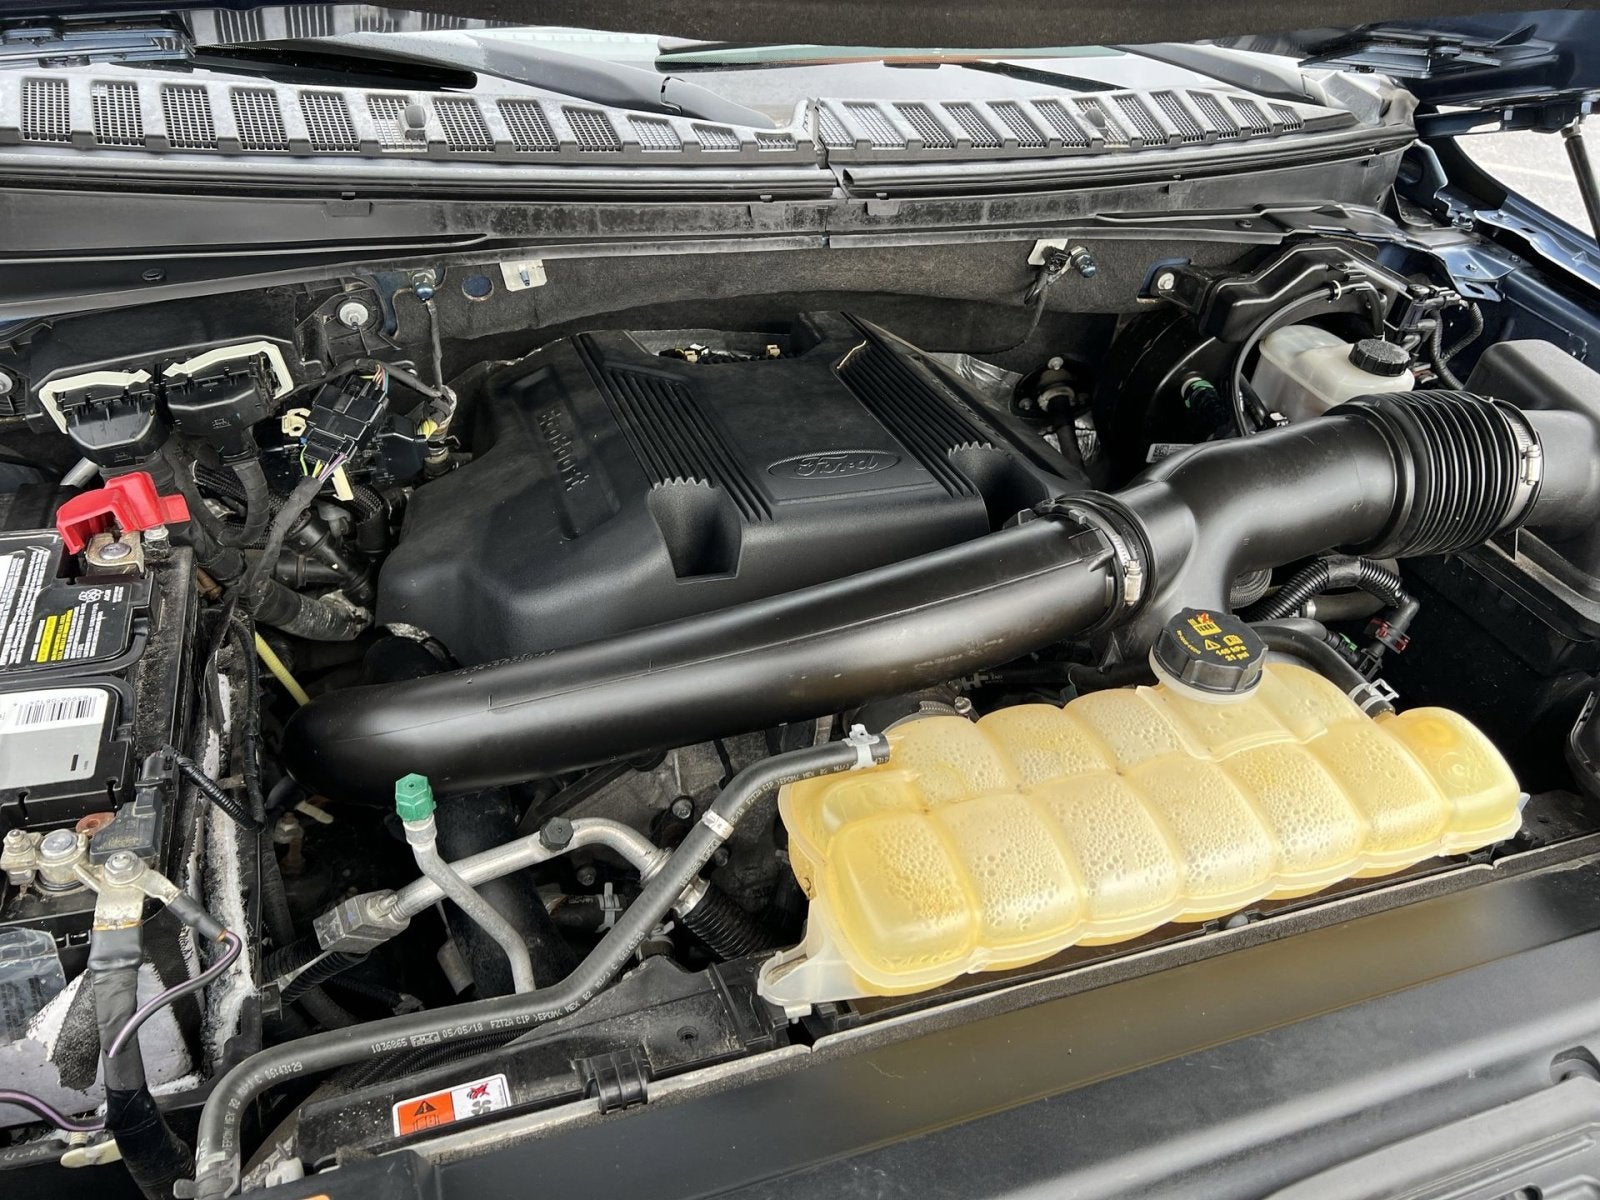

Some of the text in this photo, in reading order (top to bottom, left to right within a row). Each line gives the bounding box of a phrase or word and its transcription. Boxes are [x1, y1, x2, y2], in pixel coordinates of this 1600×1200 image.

[794, 454, 879, 477] Ford
[442, 1023, 483, 1038] 05/05/18
[566, 1001, 581, 1013] MEX
